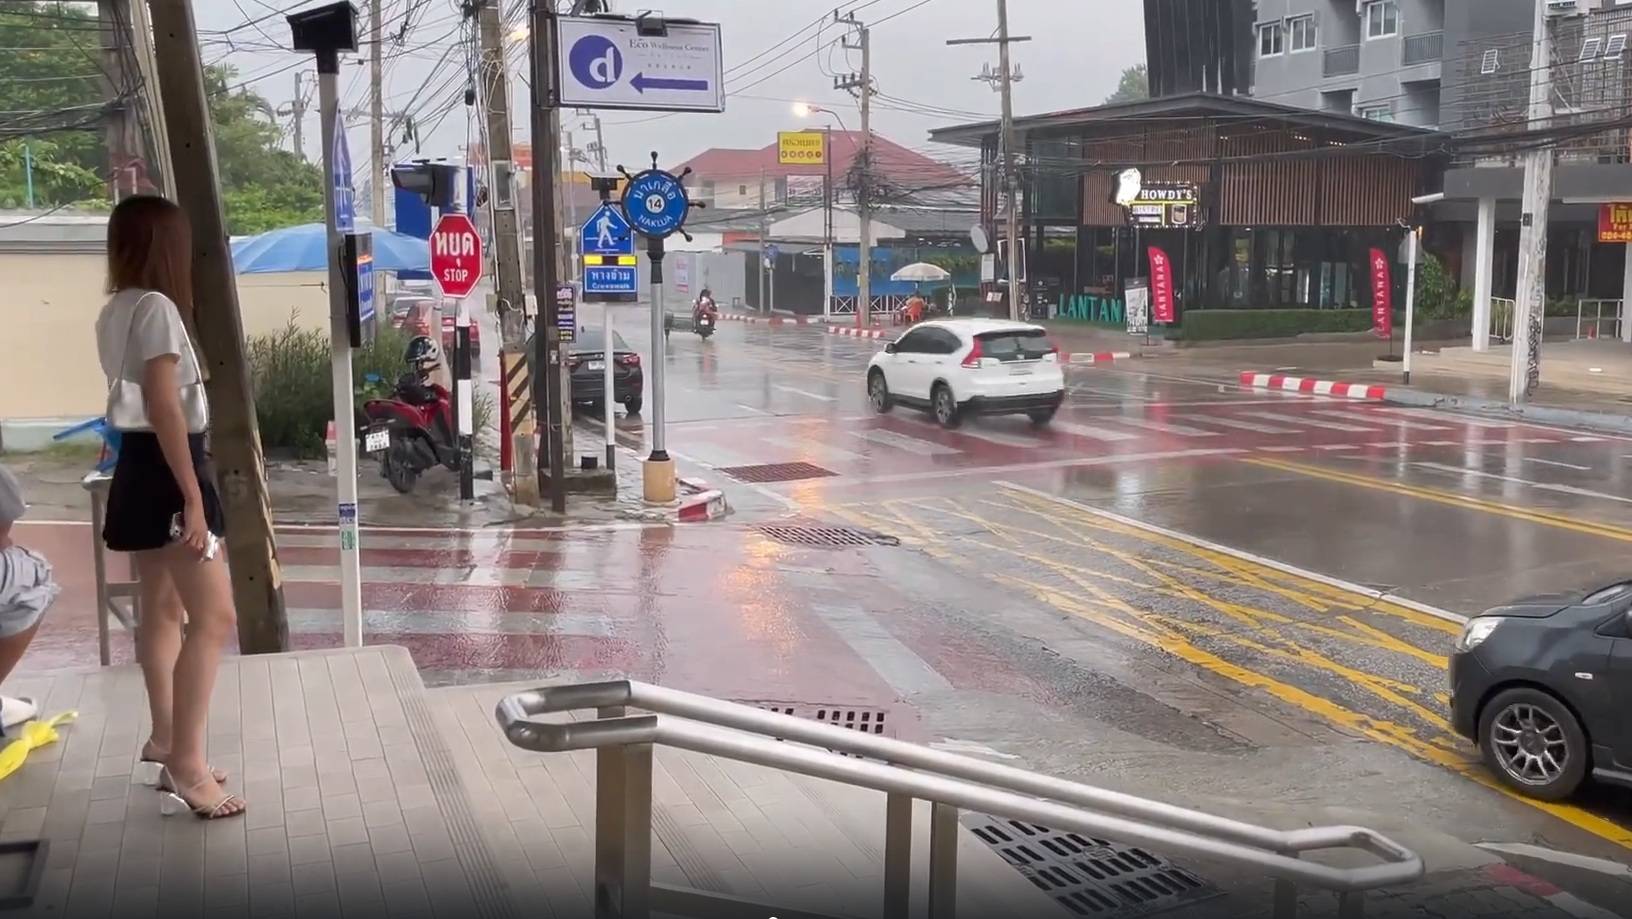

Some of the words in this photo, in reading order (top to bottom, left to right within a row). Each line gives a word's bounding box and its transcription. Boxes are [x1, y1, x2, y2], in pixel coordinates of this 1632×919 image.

[629, 39, 648, 49] Eco
[633, 180, 676, 200] นาเกลือ
[1141, 188, 1192, 200] HOWDY'S
[648, 199, 663, 209] 14
[638, 214, 673, 227] NAKLUA
[434, 231, 475, 268] หยุด
[443, 268, 469, 282] STOP
[591, 268, 630, 281] ทางข้าม
